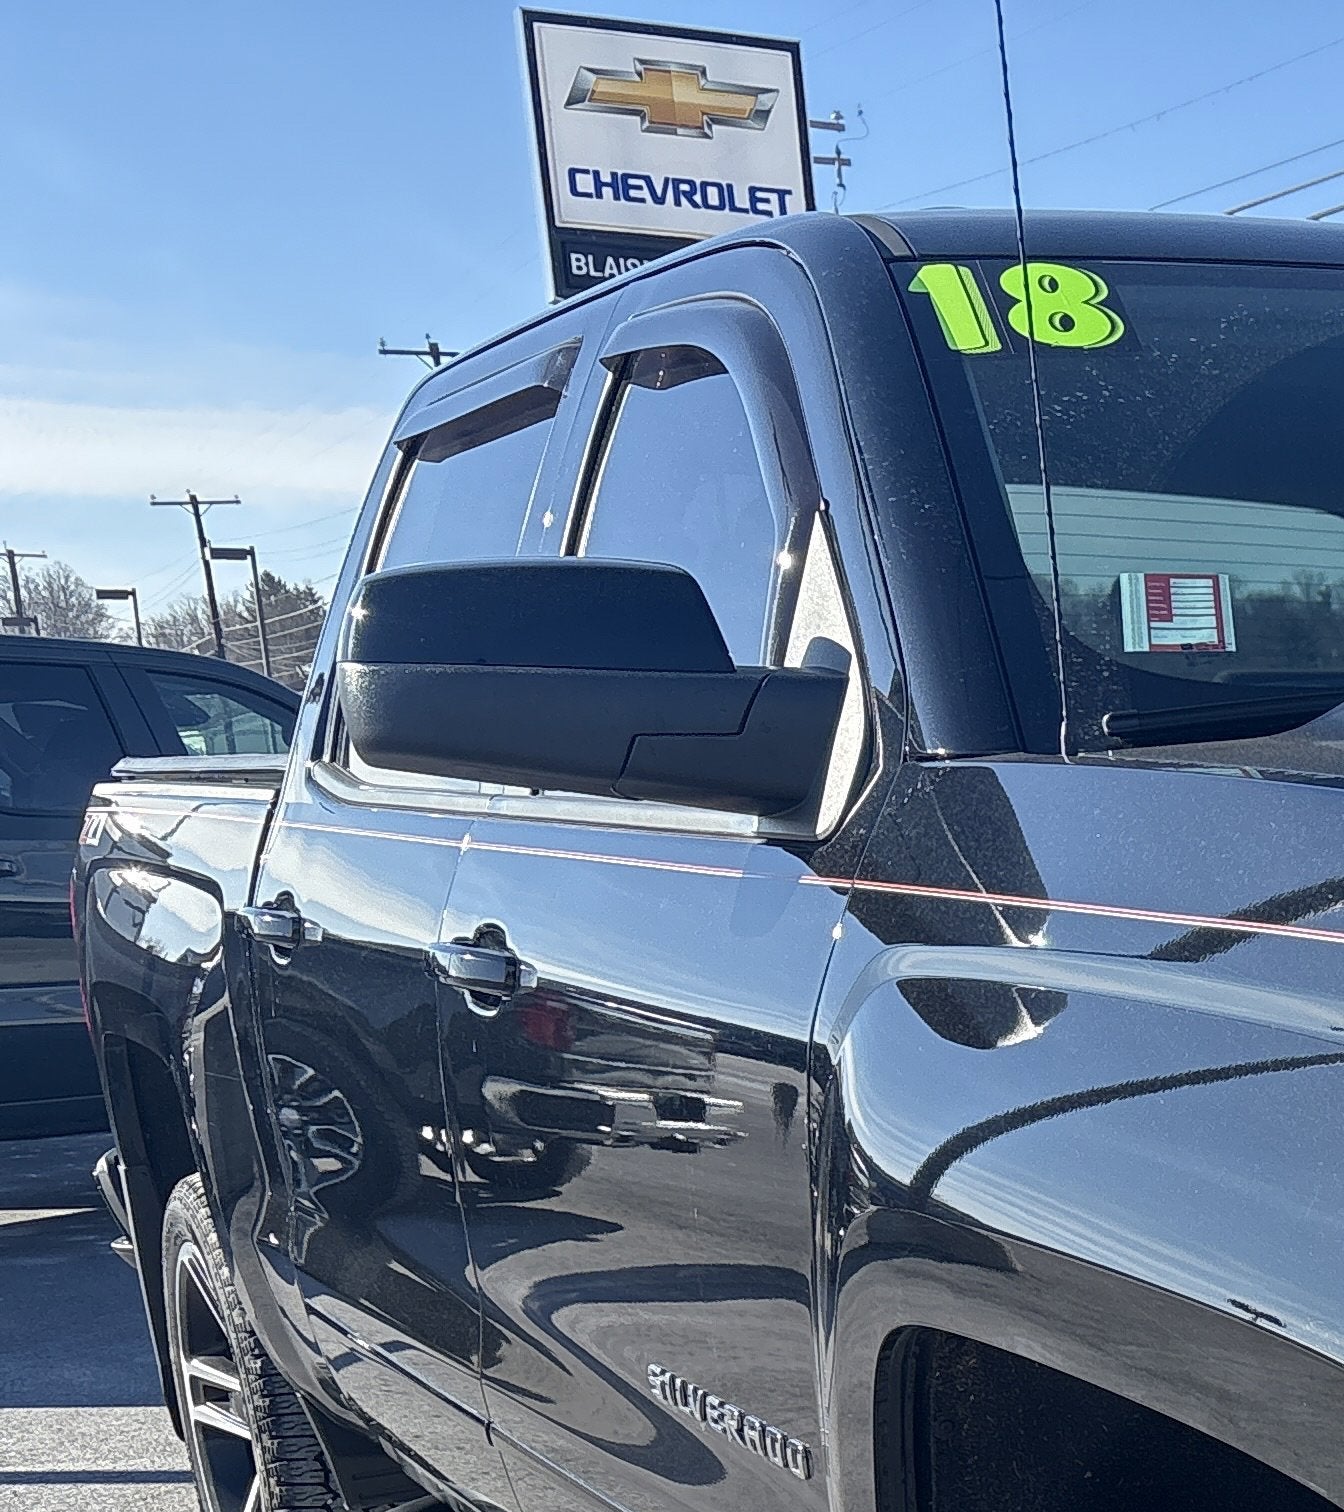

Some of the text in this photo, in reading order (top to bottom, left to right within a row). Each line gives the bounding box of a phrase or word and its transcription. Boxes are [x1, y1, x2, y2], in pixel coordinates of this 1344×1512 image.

[567, 167, 793, 218] CHEVROLET
[569, 252, 650, 278] BLAIS
[907, 262, 1125, 355] 18
[647, 1362, 815, 1481] SILVERADO
